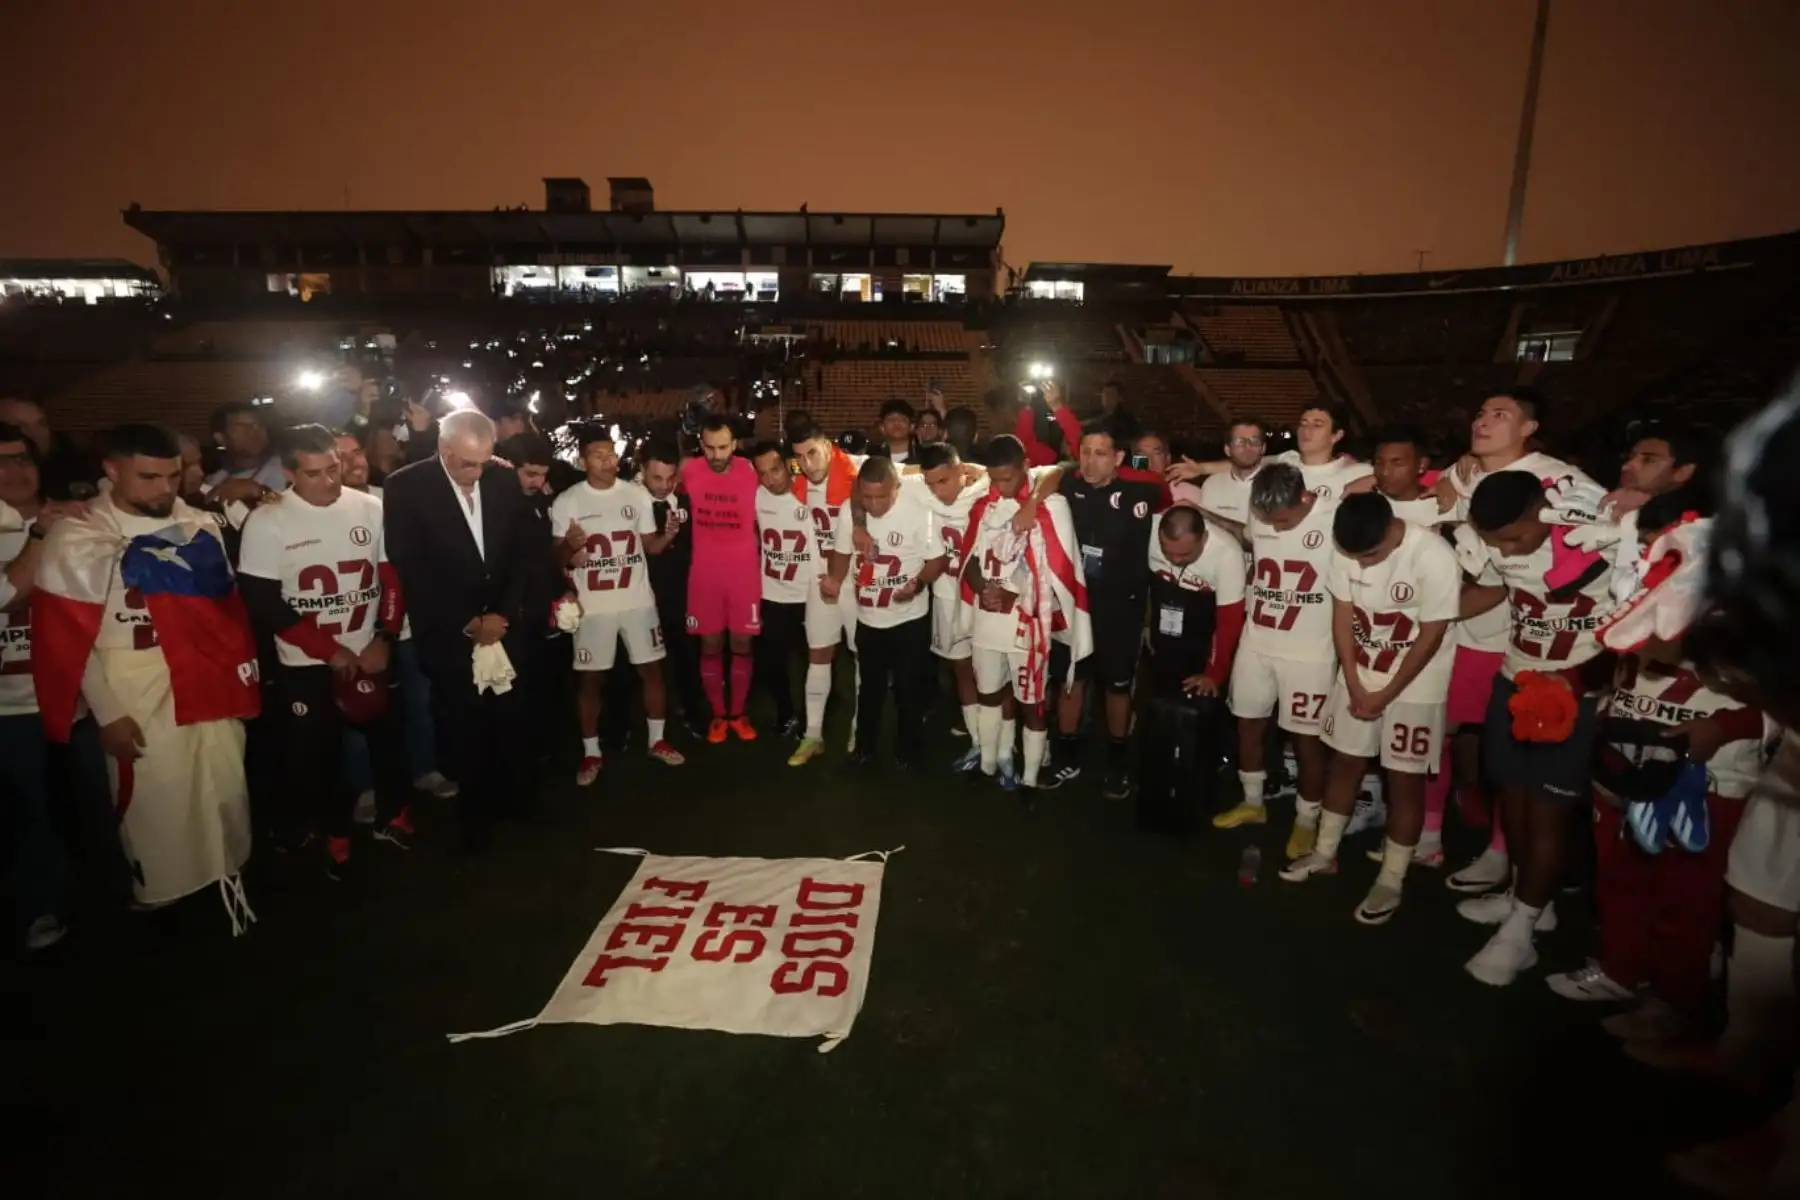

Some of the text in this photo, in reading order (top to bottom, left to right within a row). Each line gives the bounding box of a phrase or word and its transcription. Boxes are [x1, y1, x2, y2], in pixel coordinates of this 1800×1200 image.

[1549, 246, 1720, 282] ALIANZA LIMA
[1231, 278, 1351, 294] ALIANZA LIMA
[352, 528, 369, 545] U
[763, 528, 807, 581] 27
[1304, 531, 1321, 548] U
[586, 530, 636, 592] 27
[298, 559, 374, 633] 27
[1253, 558, 1318, 631] 27
[1393, 583, 1411, 602] U
[751, 603, 758, 623] 1
[1291, 692, 1327, 719] 27
[1390, 723, 1431, 756] 36
[581, 876, 709, 987] FIEL
[690, 902, 778, 963] ES
[770, 877, 865, 997] DIOS
